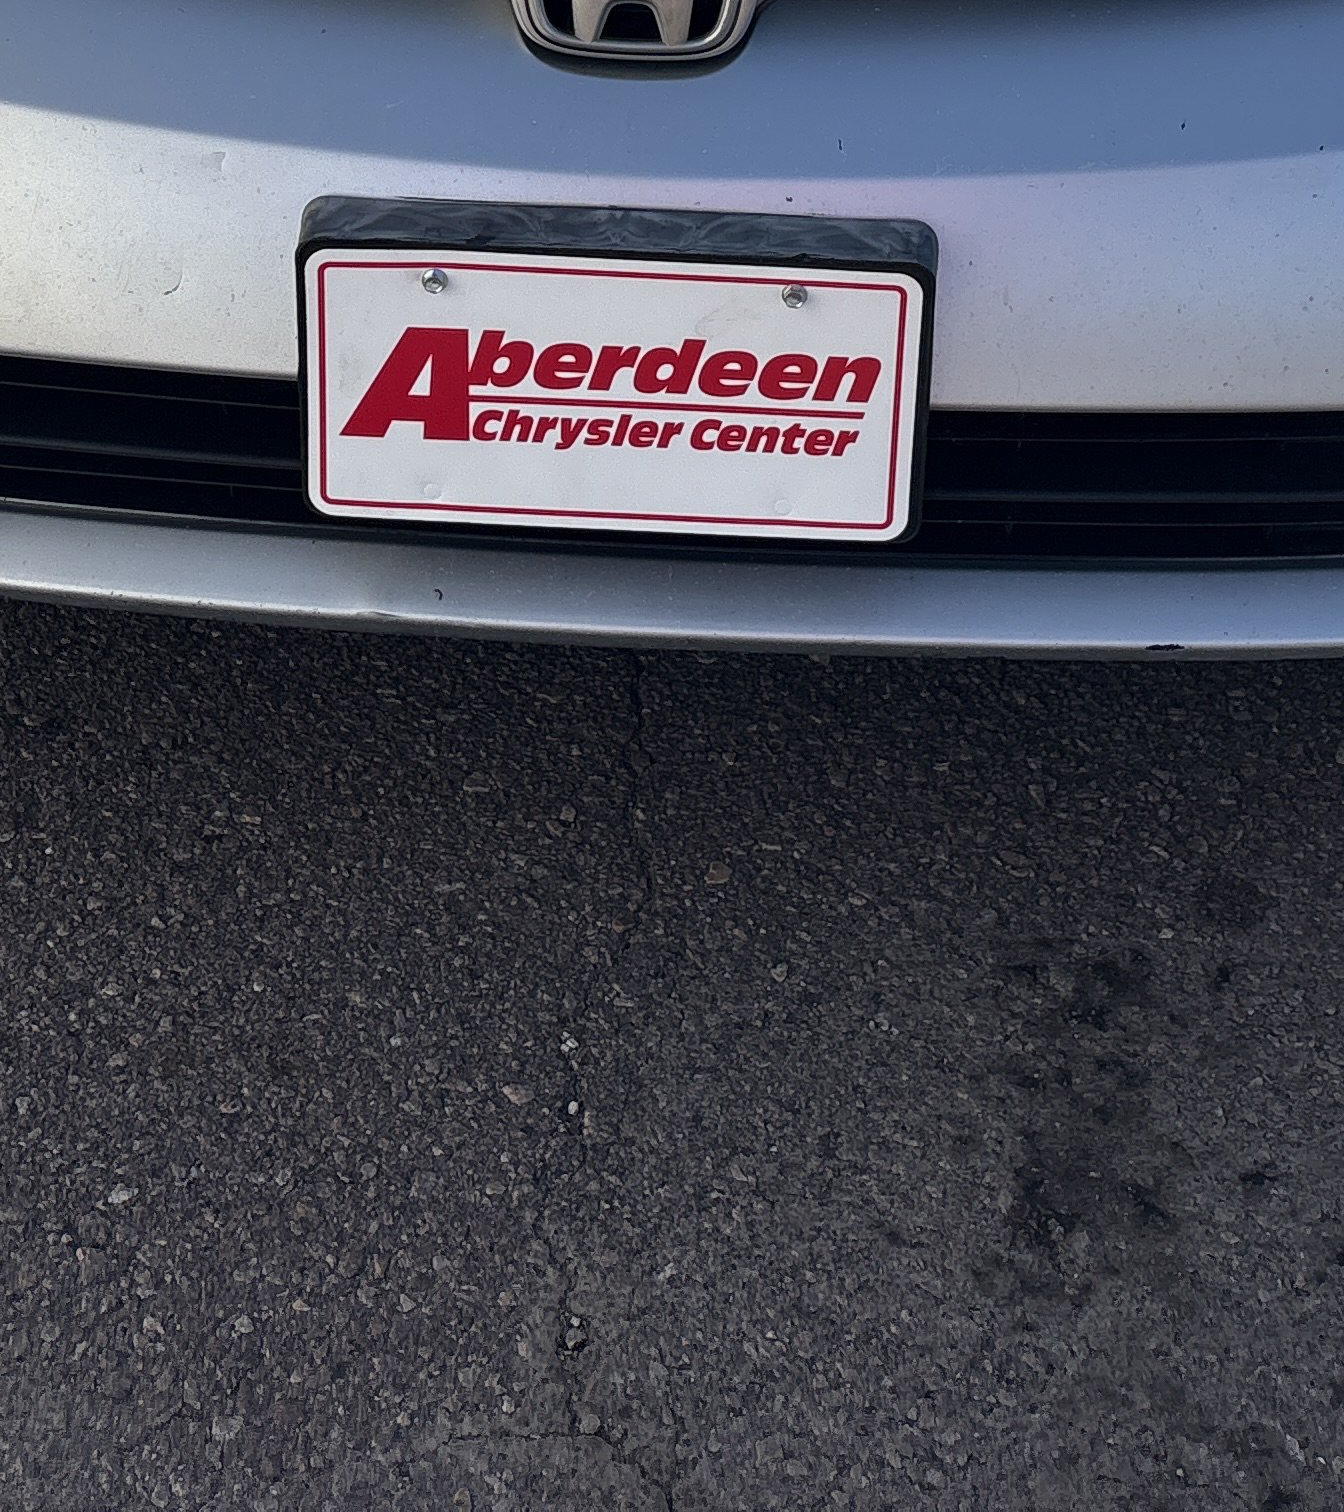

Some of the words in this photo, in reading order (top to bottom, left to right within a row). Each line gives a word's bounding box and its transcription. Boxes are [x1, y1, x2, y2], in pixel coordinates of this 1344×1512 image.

[340, 326, 882, 442] Aberdeen
[472, 409, 685, 451] Chrysler
[690, 417, 861, 458] Center
